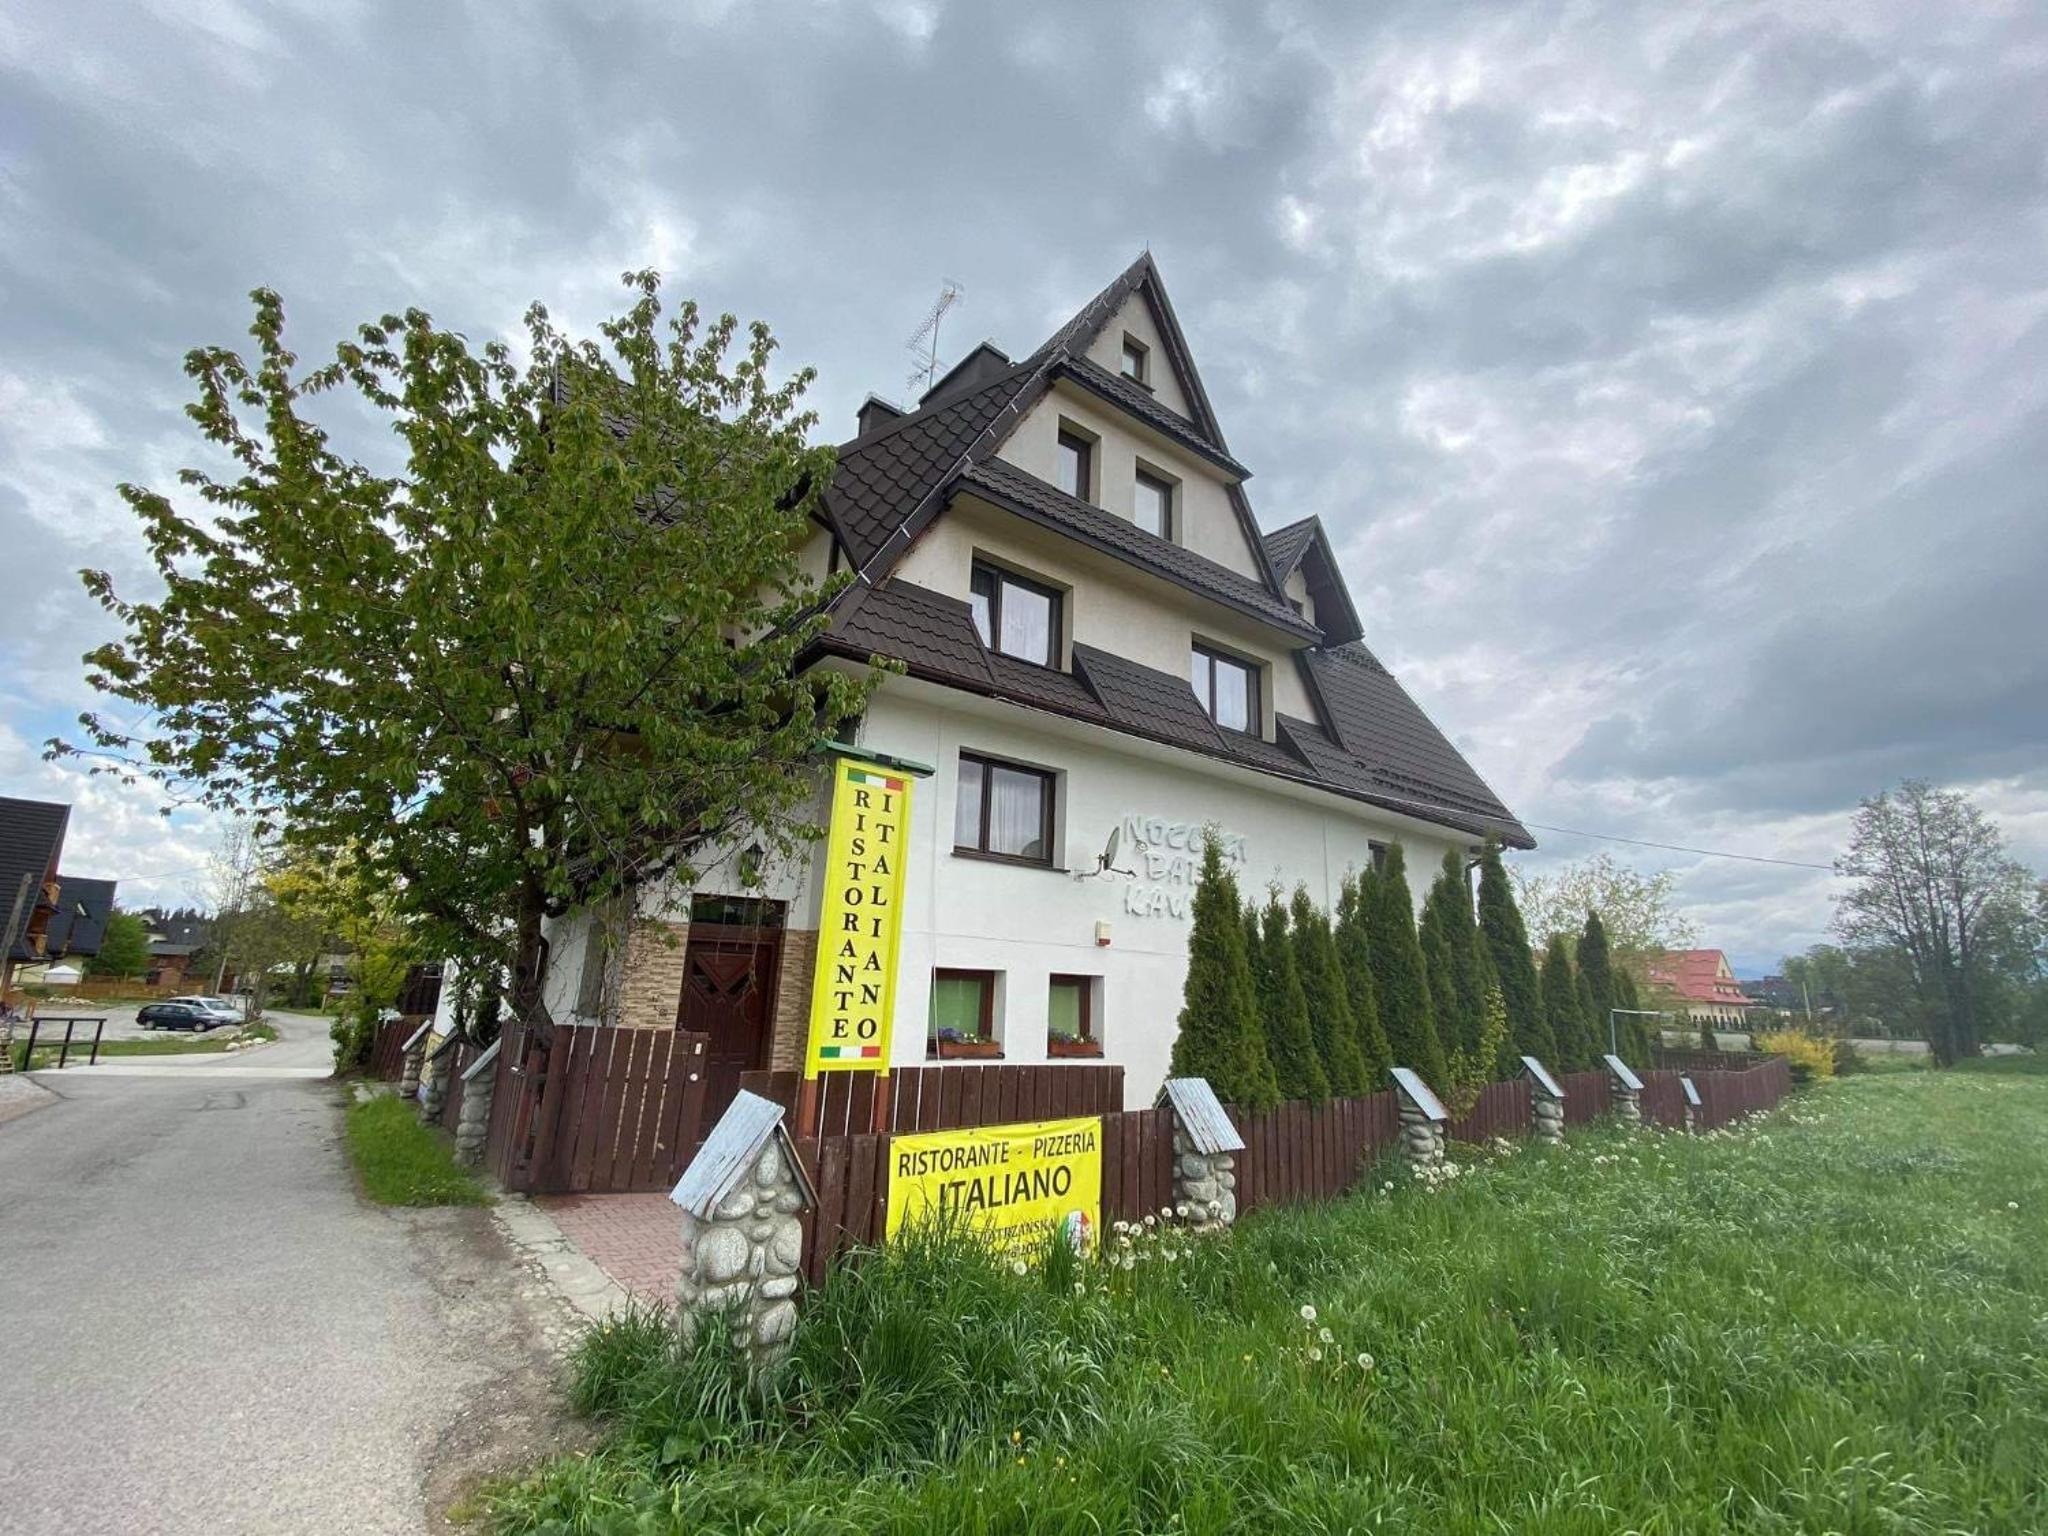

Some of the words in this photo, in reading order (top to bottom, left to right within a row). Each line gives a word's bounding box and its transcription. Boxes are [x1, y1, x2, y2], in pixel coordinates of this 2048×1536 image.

[832, 788, 871, 1040] RISTORANTE
[857, 794, 895, 1040] ITALIANO
[898, 1141, 1010, 1177] RISTORANTE
[1033, 1132, 1096, 1159] PIZZERIA
[939, 1165, 1072, 1213] ITALIANO
